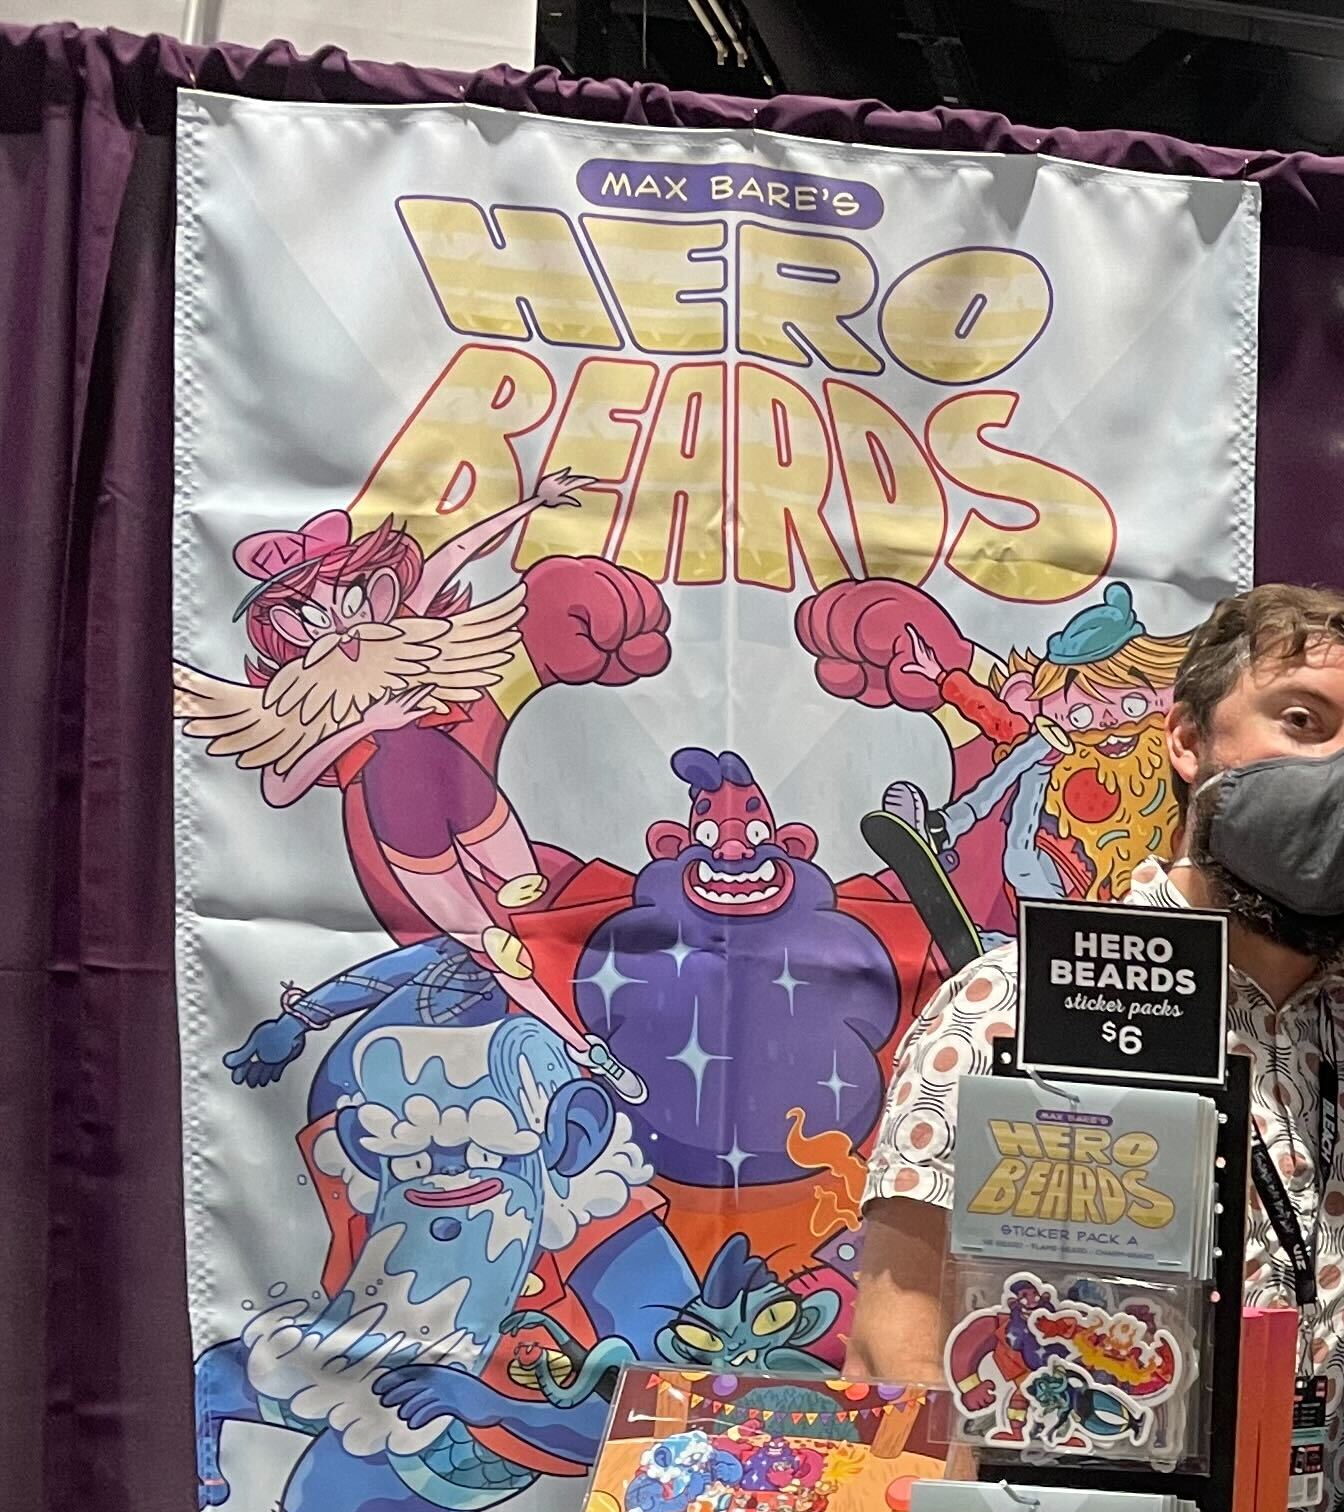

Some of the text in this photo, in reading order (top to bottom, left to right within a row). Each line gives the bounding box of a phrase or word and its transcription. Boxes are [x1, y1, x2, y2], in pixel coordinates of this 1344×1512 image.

[599, 169, 861, 217] MAX BARE'S
[396, 195, 1053, 385] HERO
[343, 343, 1117, 604] BEARDS
[1074, 931, 1174, 963] HERO
[1050, 958, 1197, 996] BEARDS
[1063, 994, 1185, 1021] sticker packs
[1102, 1021, 1143, 1056] $6
[988, 1119, 1160, 1168] HERO
[966, 1157, 1177, 1230] BEARDS
[1001, 1224, 1139, 1246] STICKER PACK A
